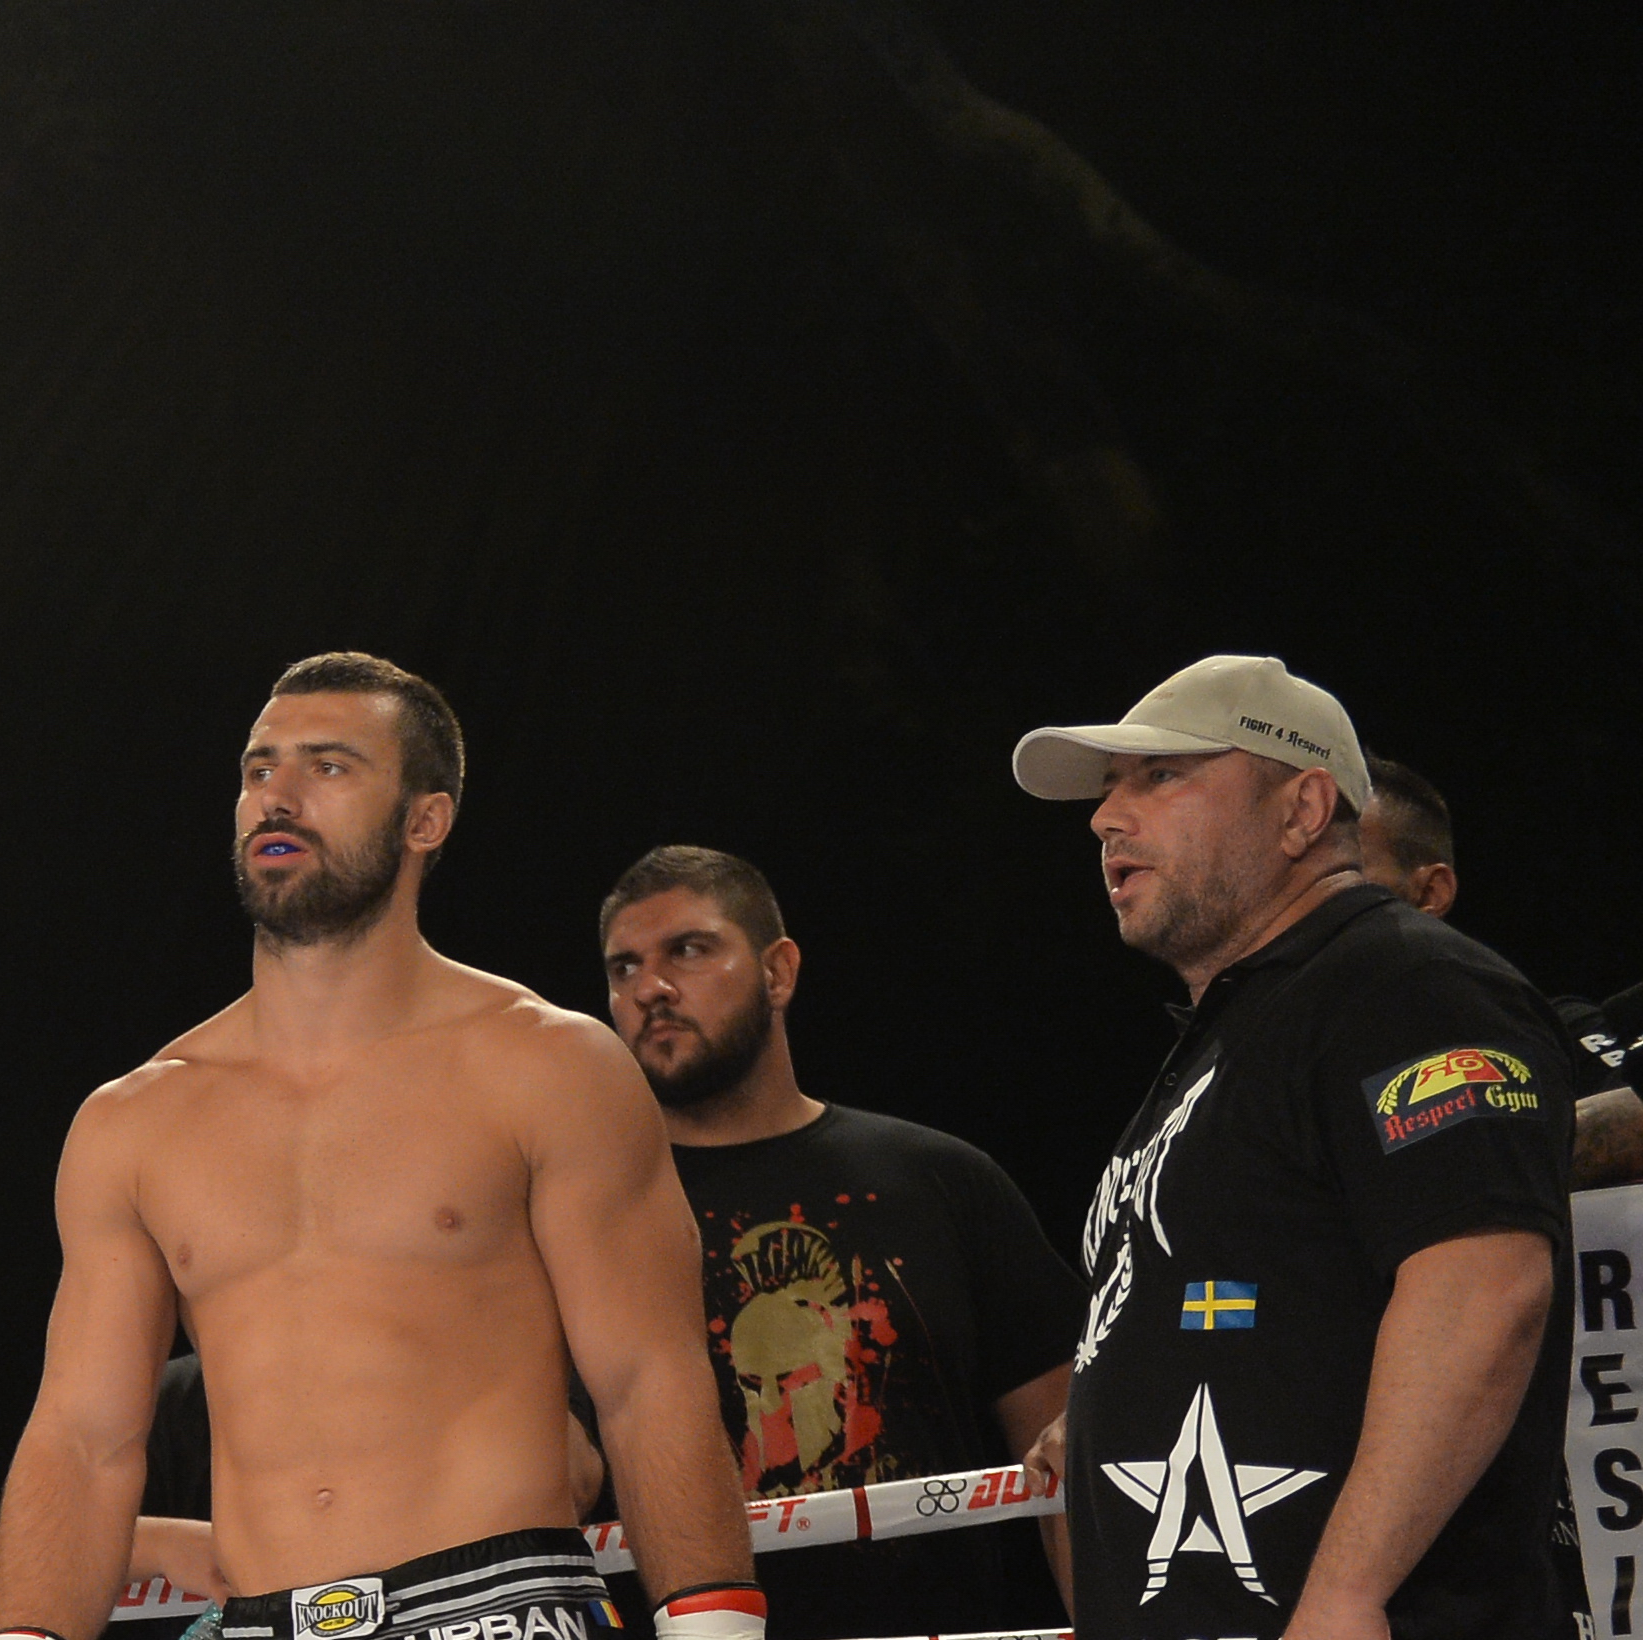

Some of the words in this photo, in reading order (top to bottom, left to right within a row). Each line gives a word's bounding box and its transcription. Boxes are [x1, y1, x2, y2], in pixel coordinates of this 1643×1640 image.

[1240, 715, 1273, 736] FIGHT
[1275, 727, 1284, 740] 4
[1383, 1087, 1478, 1143] Respect
[1484, 1084, 1539, 1113] Gym
[296, 1592, 379, 1634] KNOCKOUT
